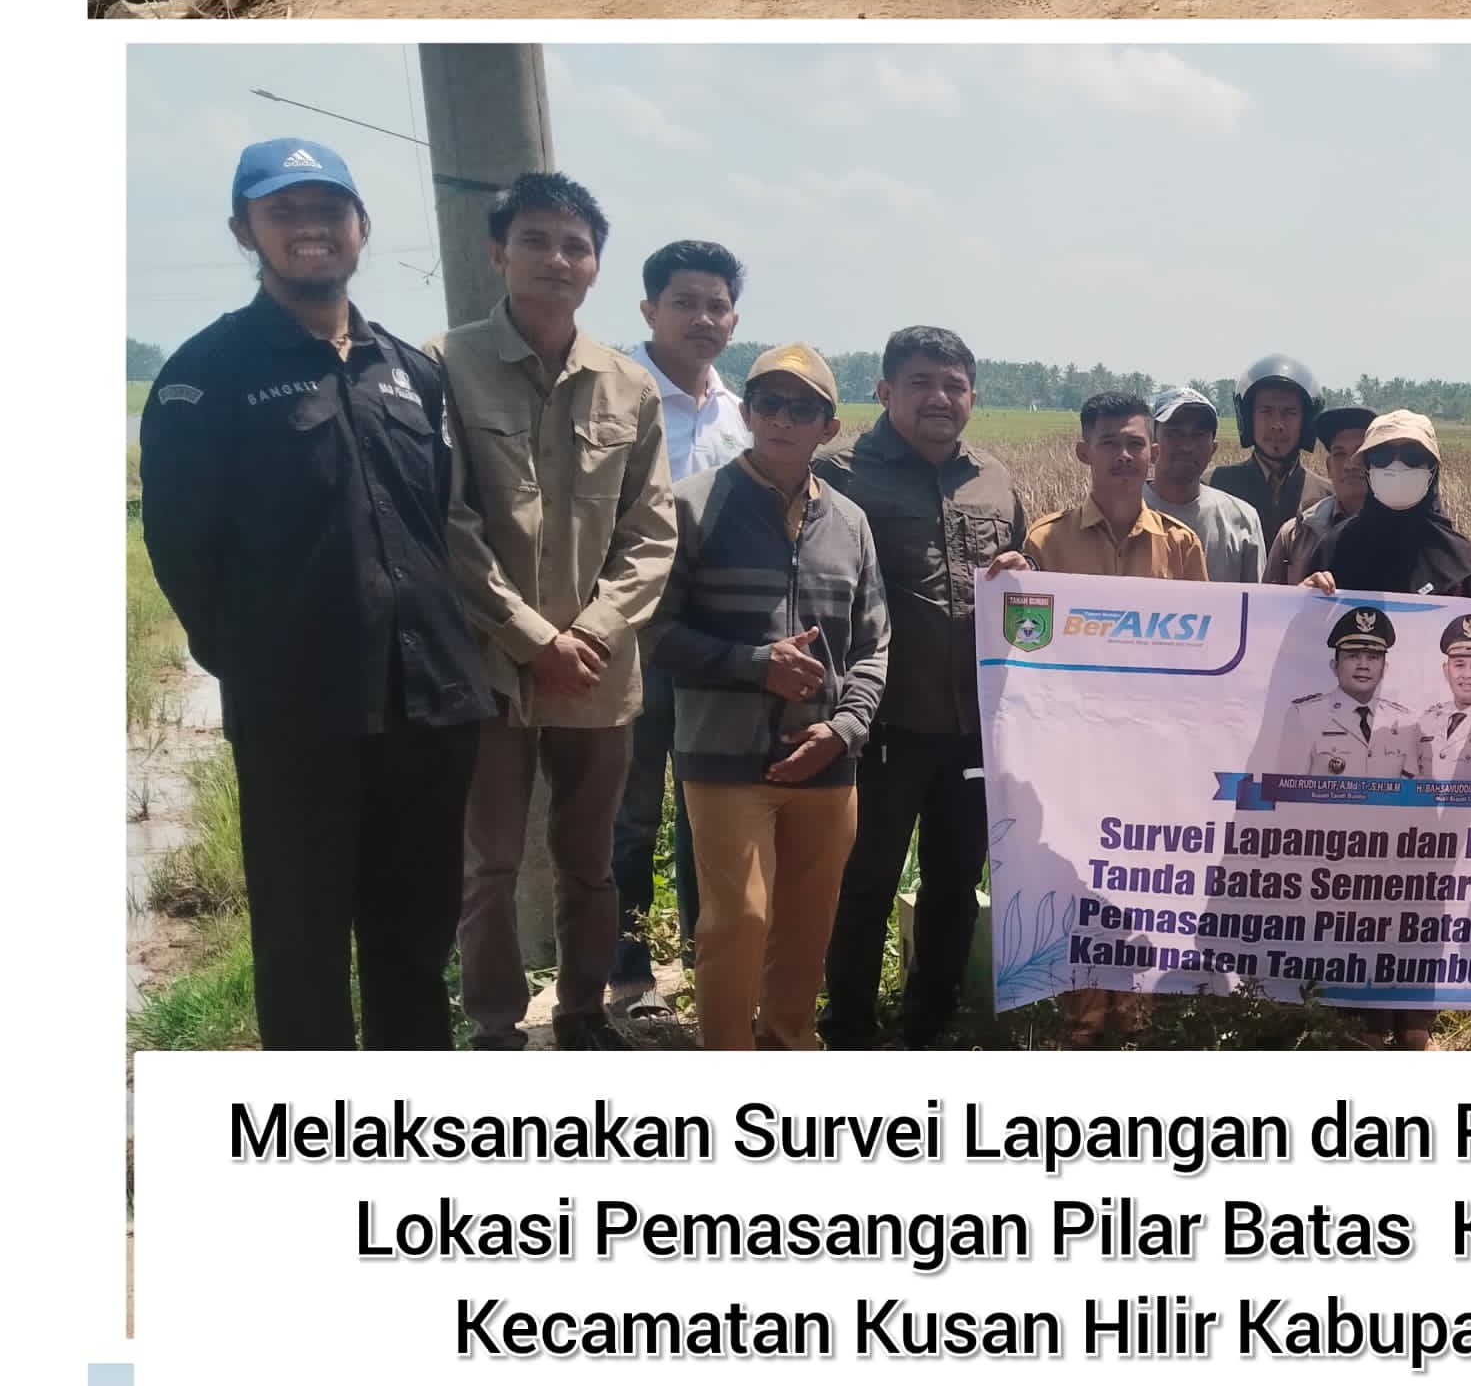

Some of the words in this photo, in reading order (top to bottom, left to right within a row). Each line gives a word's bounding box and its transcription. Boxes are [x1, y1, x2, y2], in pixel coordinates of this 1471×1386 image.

[1100, 817, 1215, 853] Survei
[1224, 821, 1388, 861] Lapangan
[1397, 827, 1458, 859] dan
[1089, 860, 1195, 896] Tanda
[1205, 866, 1302, 900] Batas
[1080, 898, 1305, 943] Pemasangan
[1313, 911, 1392, 943] Pilar
[1069, 935, 1257, 976] Kabupaten
[1266, 950, 1367, 983] Tanah
